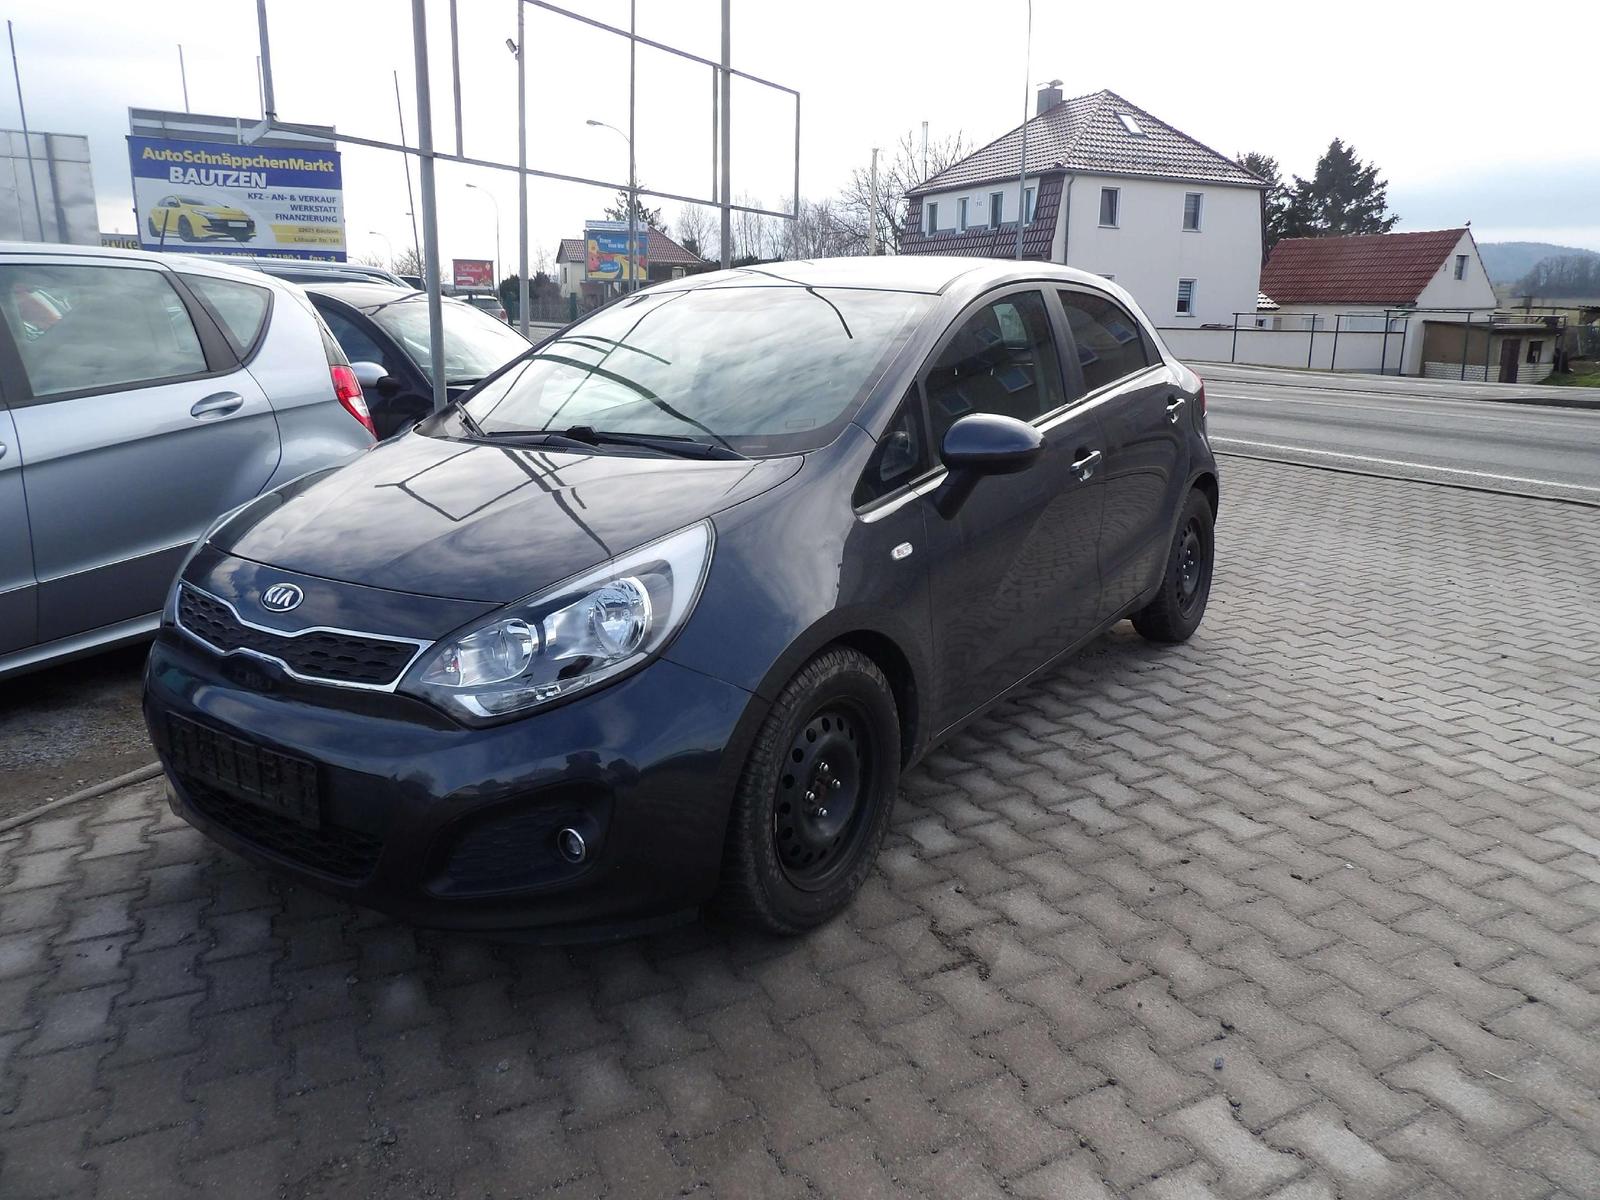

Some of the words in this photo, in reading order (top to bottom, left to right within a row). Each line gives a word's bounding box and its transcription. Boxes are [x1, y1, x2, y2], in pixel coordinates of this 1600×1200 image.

[142, 147, 335, 172] AutoSchnäppchenMarkt
[169, 166, 267, 189] BAUTZEN
[247, 192, 264, 200] KFZ
[298, 194, 337, 204] VERKAUF
[290, 204, 337, 213] WERKSTATT
[275, 213, 338, 223] FINANZIERUNG
[264, 586, 295, 607] KIA
